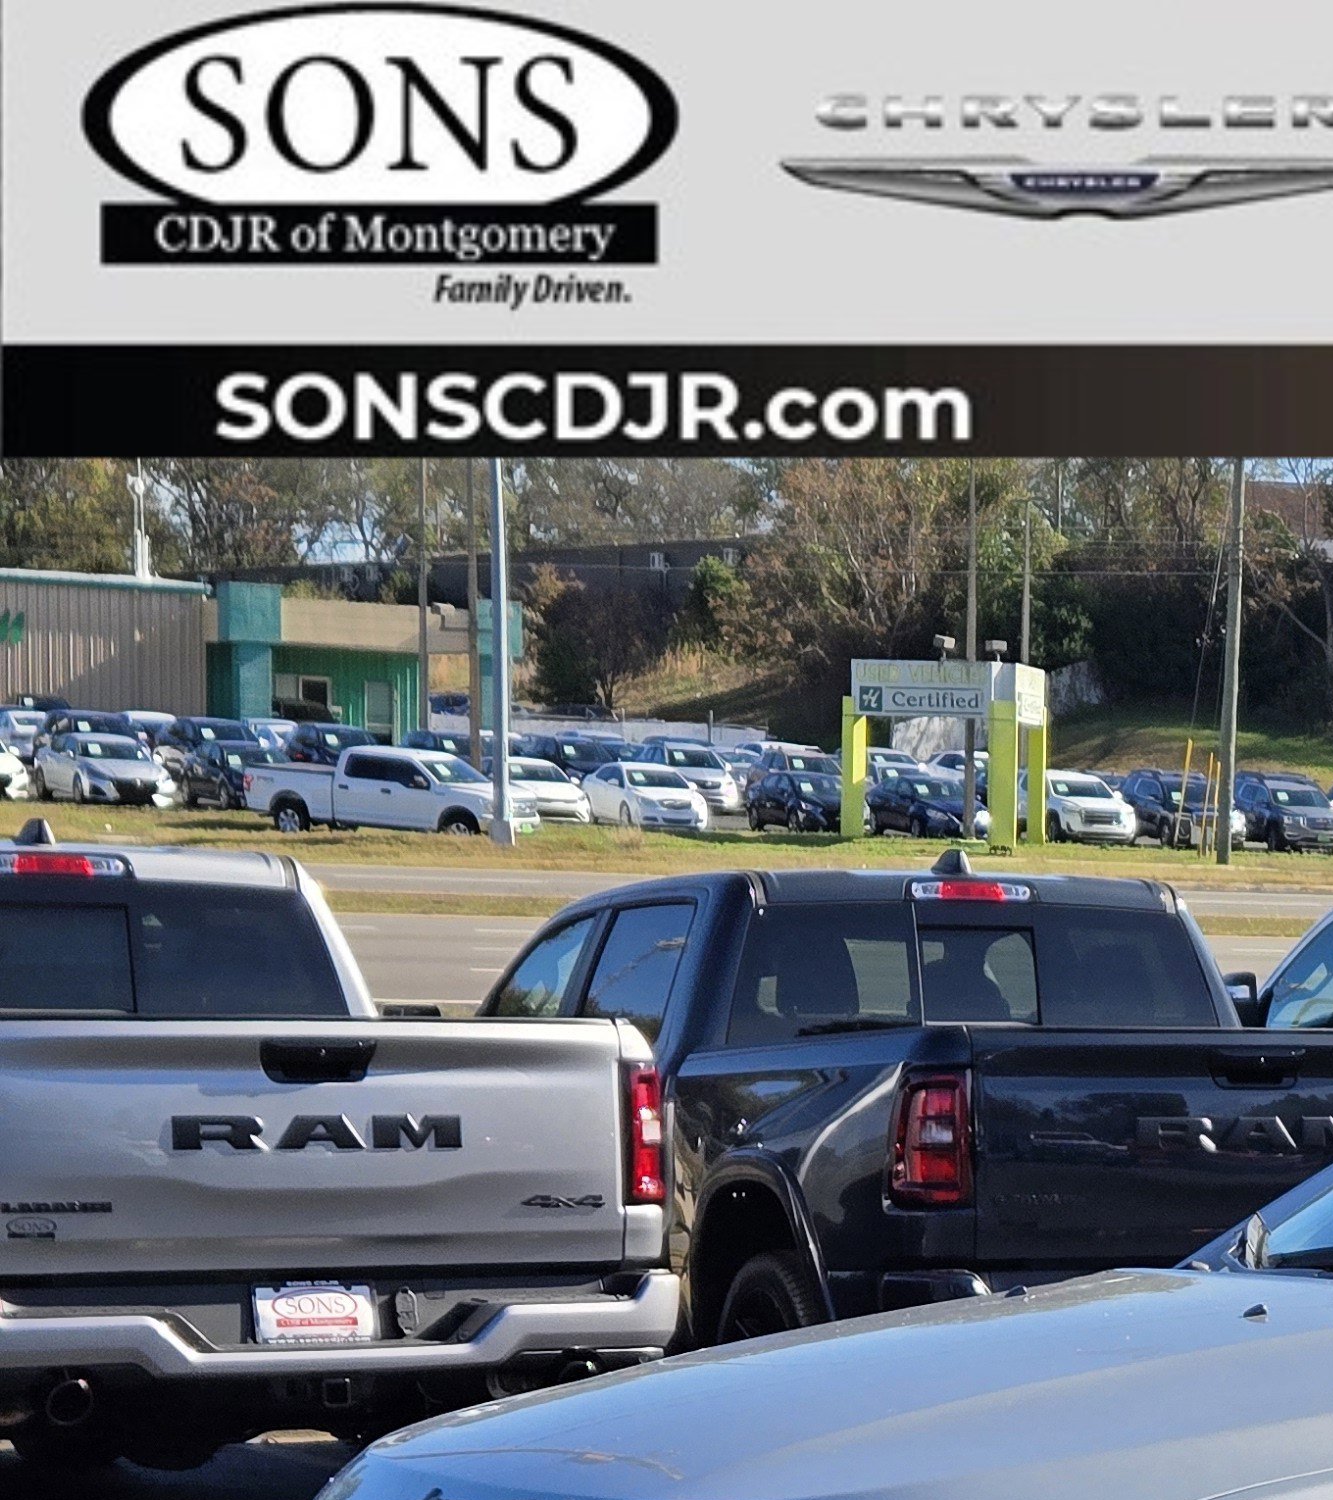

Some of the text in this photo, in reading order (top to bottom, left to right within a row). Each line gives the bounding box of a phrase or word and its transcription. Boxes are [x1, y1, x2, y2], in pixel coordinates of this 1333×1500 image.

[892, 691, 979, 709] Certified
[171, 1113, 462, 1150] RAM
[285, 1296, 346, 1315] SONS
